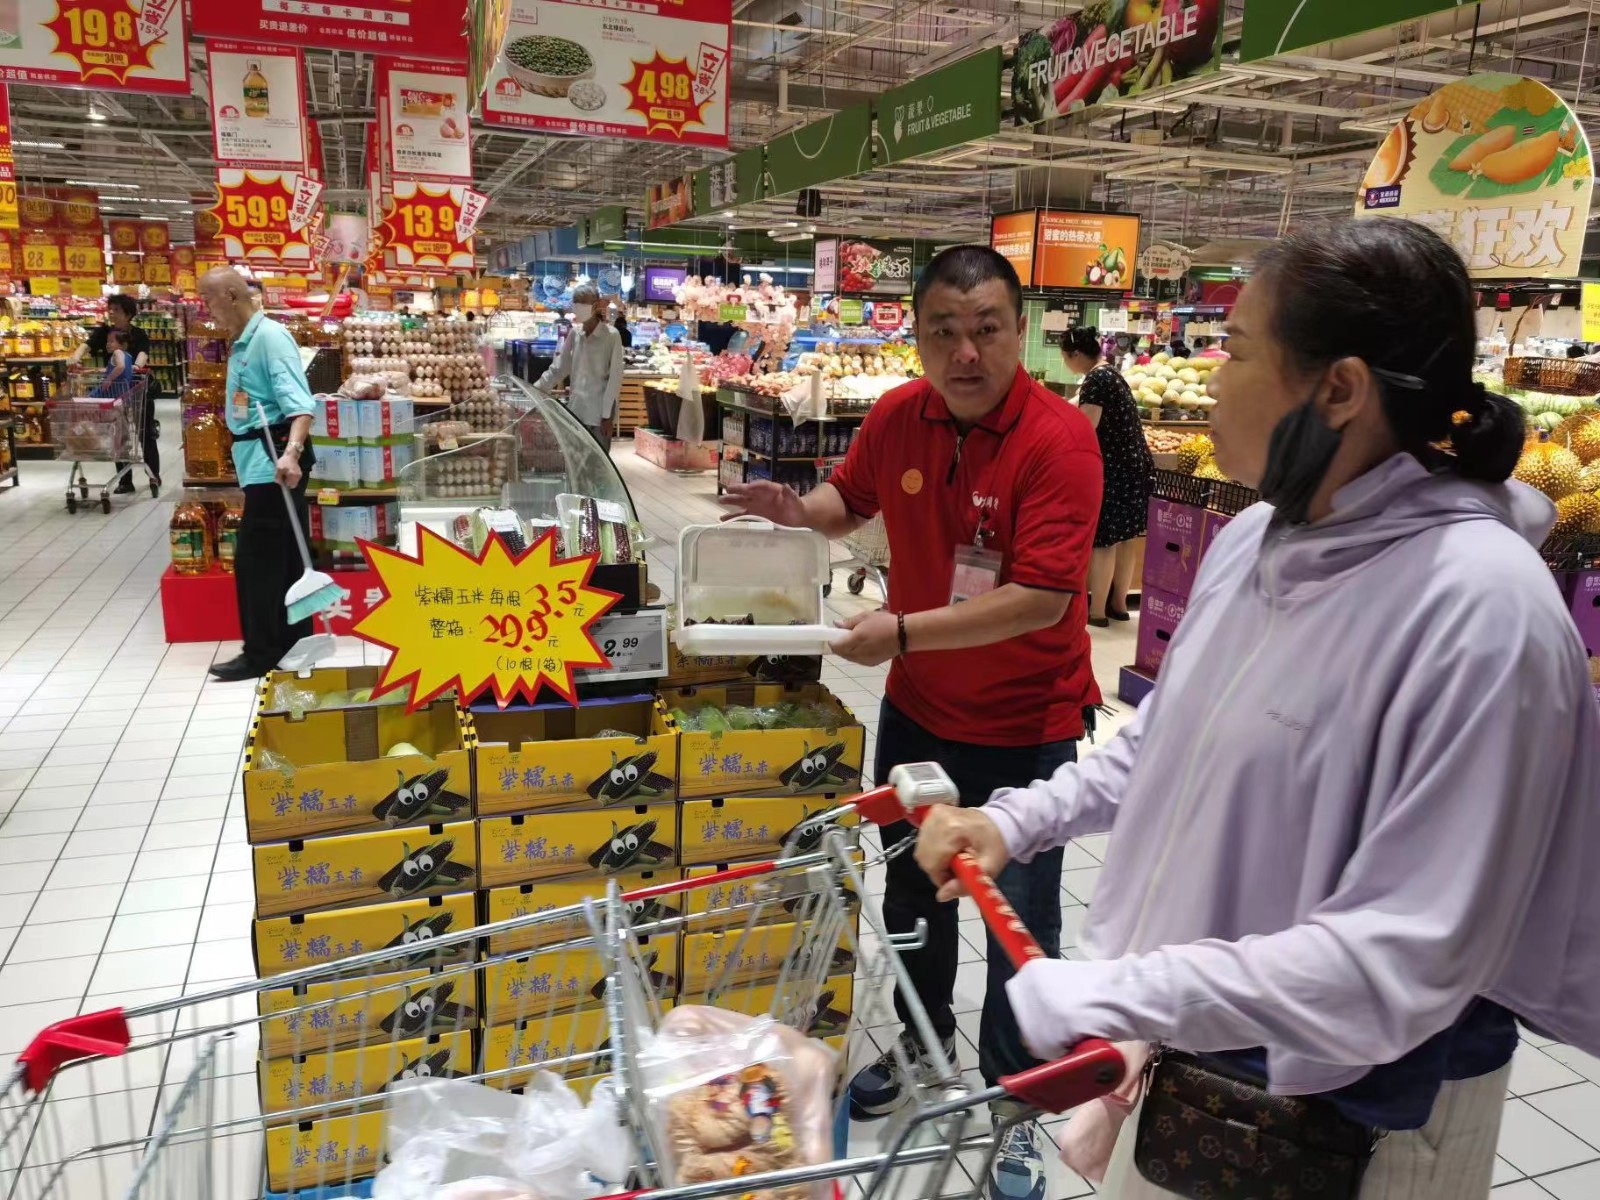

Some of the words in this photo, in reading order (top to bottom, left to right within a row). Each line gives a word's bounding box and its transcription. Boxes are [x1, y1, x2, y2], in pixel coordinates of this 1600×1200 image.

[64, 7, 132, 47] 19.8
[699, 52, 721, 86] 立省
[638, 69, 690, 104] 4.98
[907, 119, 925, 136] FRUIT
[931, 103, 972, 128] VEGETABLE
[225, 195, 287, 228] 59.9
[296, 189, 313, 212] 立省
[461, 202, 479, 228] 立省
[399, 204, 455, 238] 13.9
[603, 637, 639, 658] 2.99
